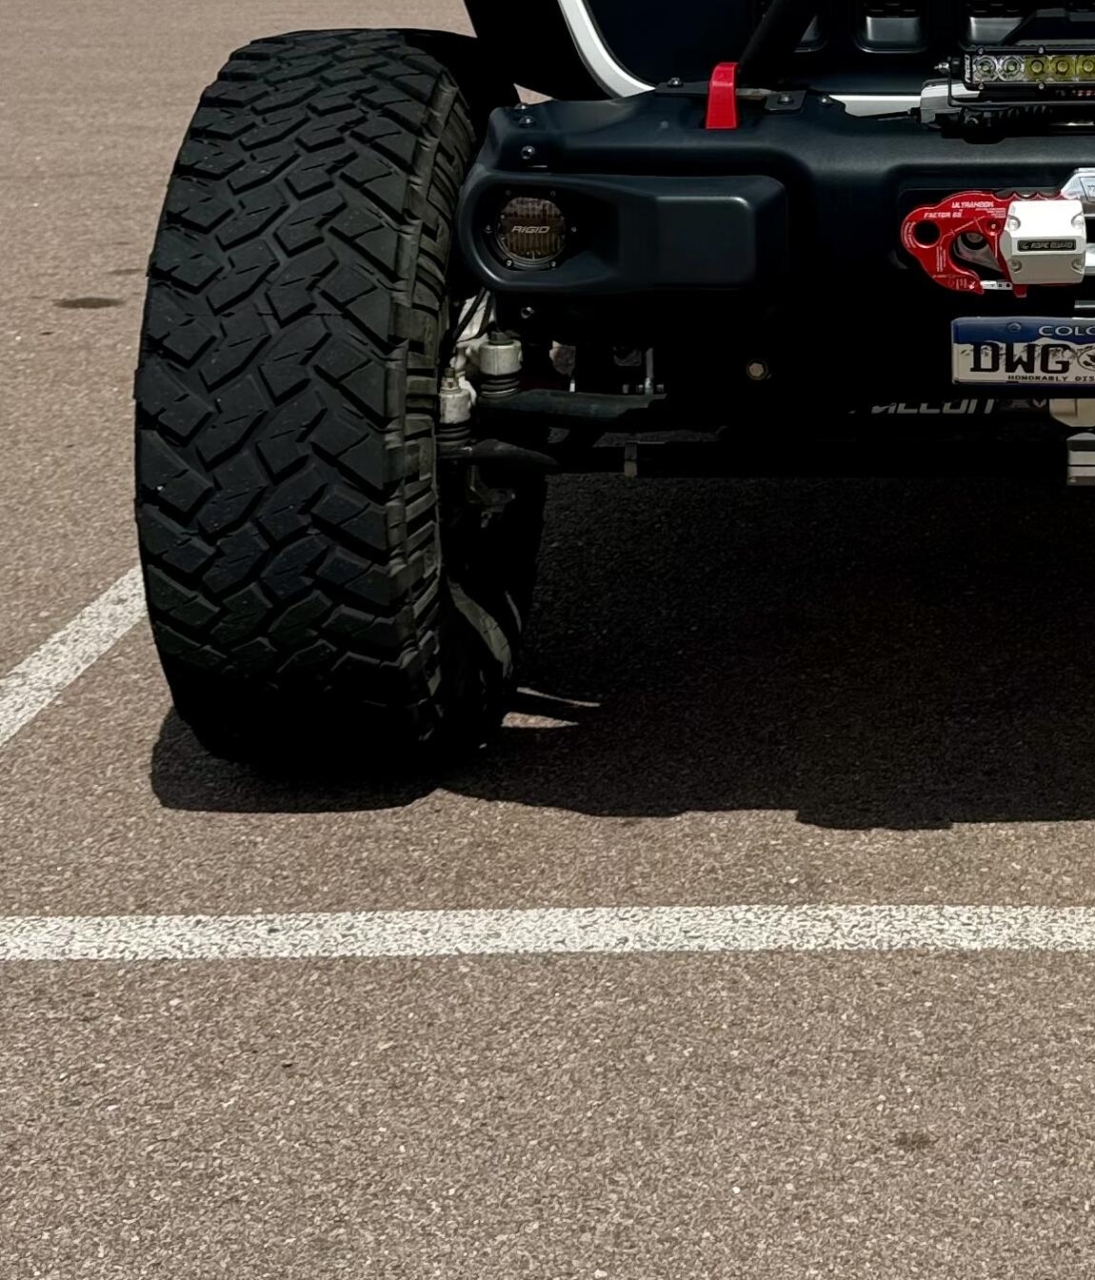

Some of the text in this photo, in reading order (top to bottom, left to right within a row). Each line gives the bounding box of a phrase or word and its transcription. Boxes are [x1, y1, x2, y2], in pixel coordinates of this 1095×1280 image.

[511, 225, 550, 234] RIGID
[969, 340, 1070, 374] DWG
[1008, 374, 1069, 382] HONORABLY
